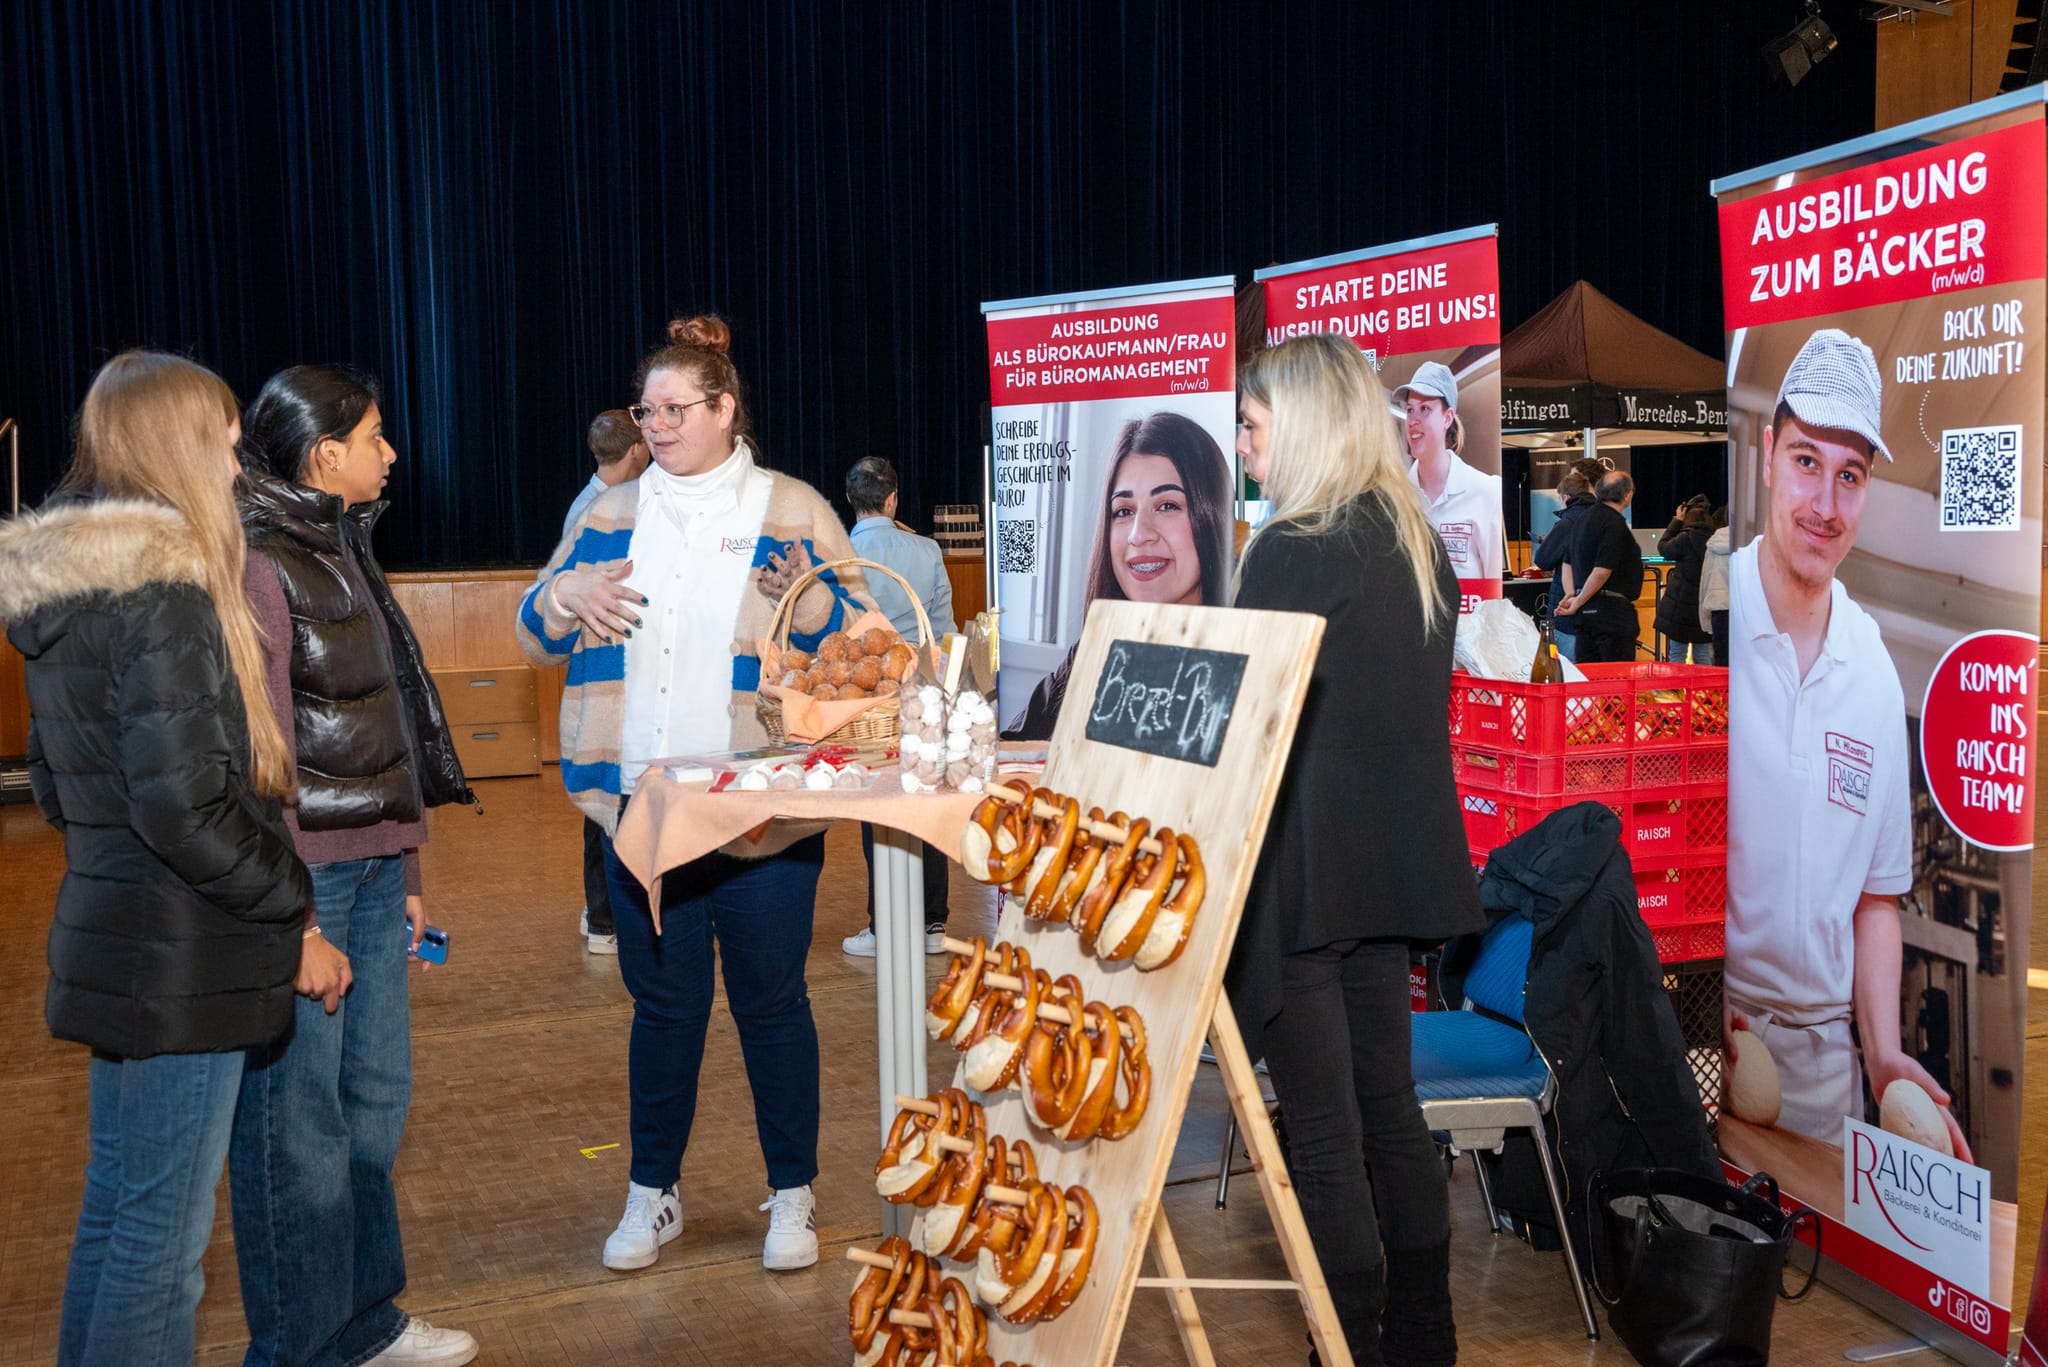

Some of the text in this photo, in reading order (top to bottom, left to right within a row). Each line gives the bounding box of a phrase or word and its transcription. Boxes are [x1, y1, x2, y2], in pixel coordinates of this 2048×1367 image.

[1751, 152, 1988, 245] AUSBILDUNG
[1750, 218, 1985, 302] ZUM BÄCKER
[1295, 262, 1447, 310] STARTE DEINE
[1931, 264, 1985, 292] (m/w/d)
[1051, 313, 1159, 339] AUSBILDUNG
[1396, 302, 1431, 331] BEI
[1438, 293, 1496, 325] UNS!
[1943, 299, 2024, 342] BACK DIR
[994, 332, 1226, 367] ALS BÜROKAUFMANN/FRAU
[1896, 341, 2024, 385] DEINE ZUKUNFT!
[1006, 358, 1209, 388] FÜR BÜROMANAGEMENT
[1170, 378, 1209, 392] (m/w/d)
[1500, 400, 1570, 421] elfingen
[996, 420, 1039, 441] SCHREIBE
[996, 441, 1077, 463] DEINE ERFOLGS-
[997, 465, 1071, 486] GESCHICHTE IM
[997, 485, 1026, 508] BÜRO!
[720, 537, 758, 555] RAISC
[1990, 703, 2027, 739] INS
[1956, 738, 2025, 776] RAISCH
[1960, 776, 2024, 814] TEAM!
[1637, 826, 1671, 841] RAISCH
[1852, 1130, 1982, 1251] RAISCH
[1884, 1189, 1982, 1242] Bäckerei & Konditorei
